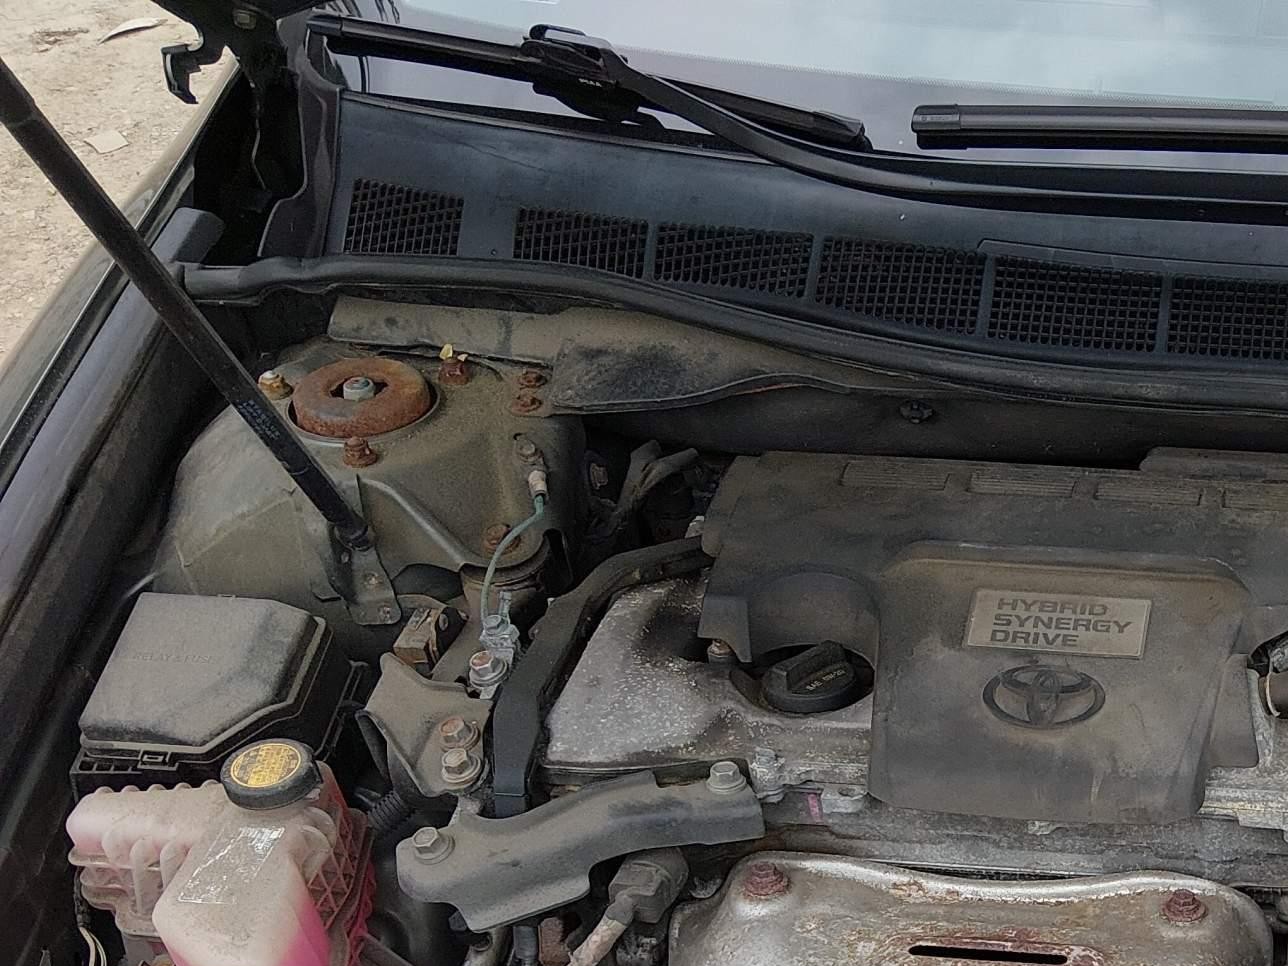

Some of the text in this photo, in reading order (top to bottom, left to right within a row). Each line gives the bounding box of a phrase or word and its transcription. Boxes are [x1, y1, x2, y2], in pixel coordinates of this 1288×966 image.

[996, 597, 1110, 617] HYBRID
[992, 613, 1134, 635] SYNERGY
[989, 629, 1081, 648] DRIVE
